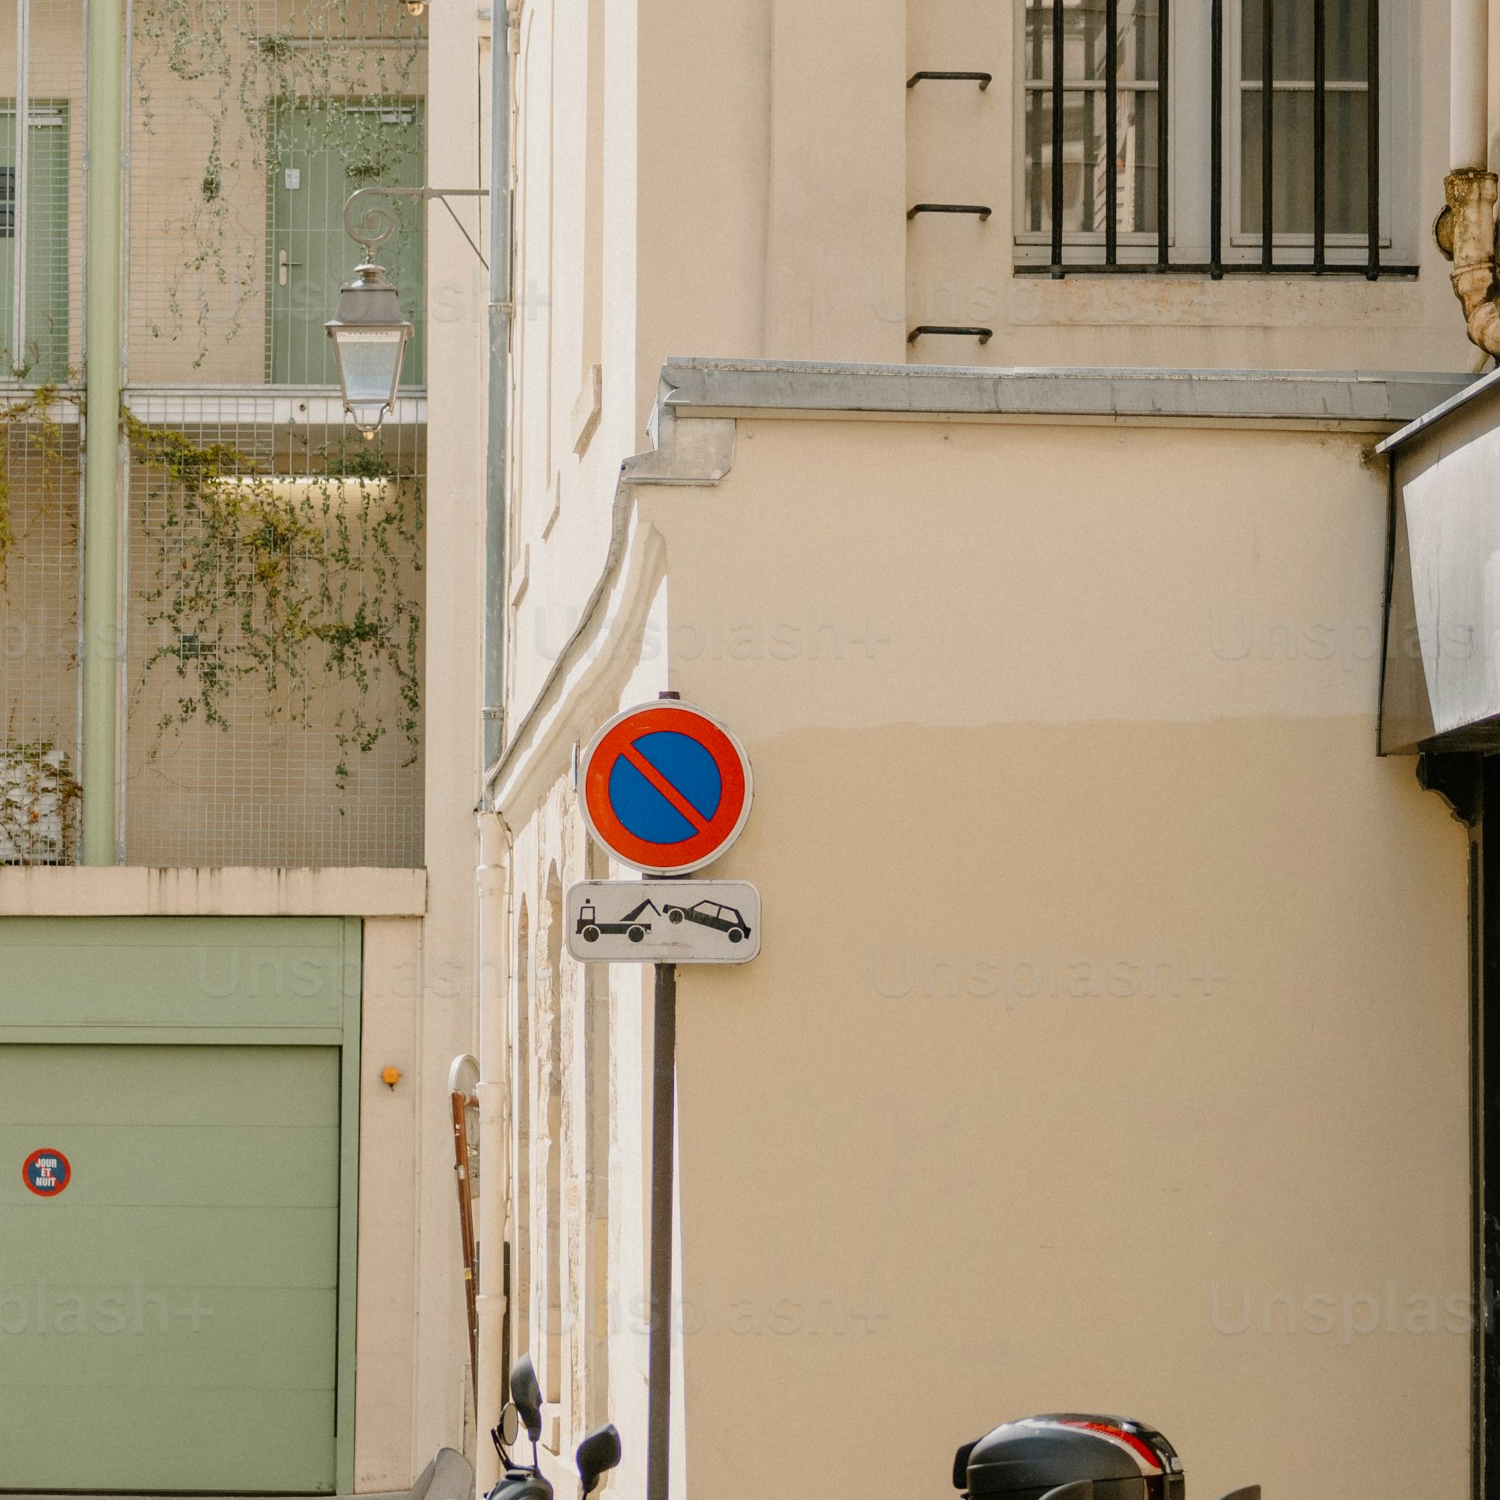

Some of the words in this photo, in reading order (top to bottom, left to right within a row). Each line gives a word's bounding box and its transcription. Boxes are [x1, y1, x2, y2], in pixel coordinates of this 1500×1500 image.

[35, 1158, 57, 1168] JOUR
[41, 1168, 51, 1177] ET
[36, 1177, 56, 1186] NUIT
